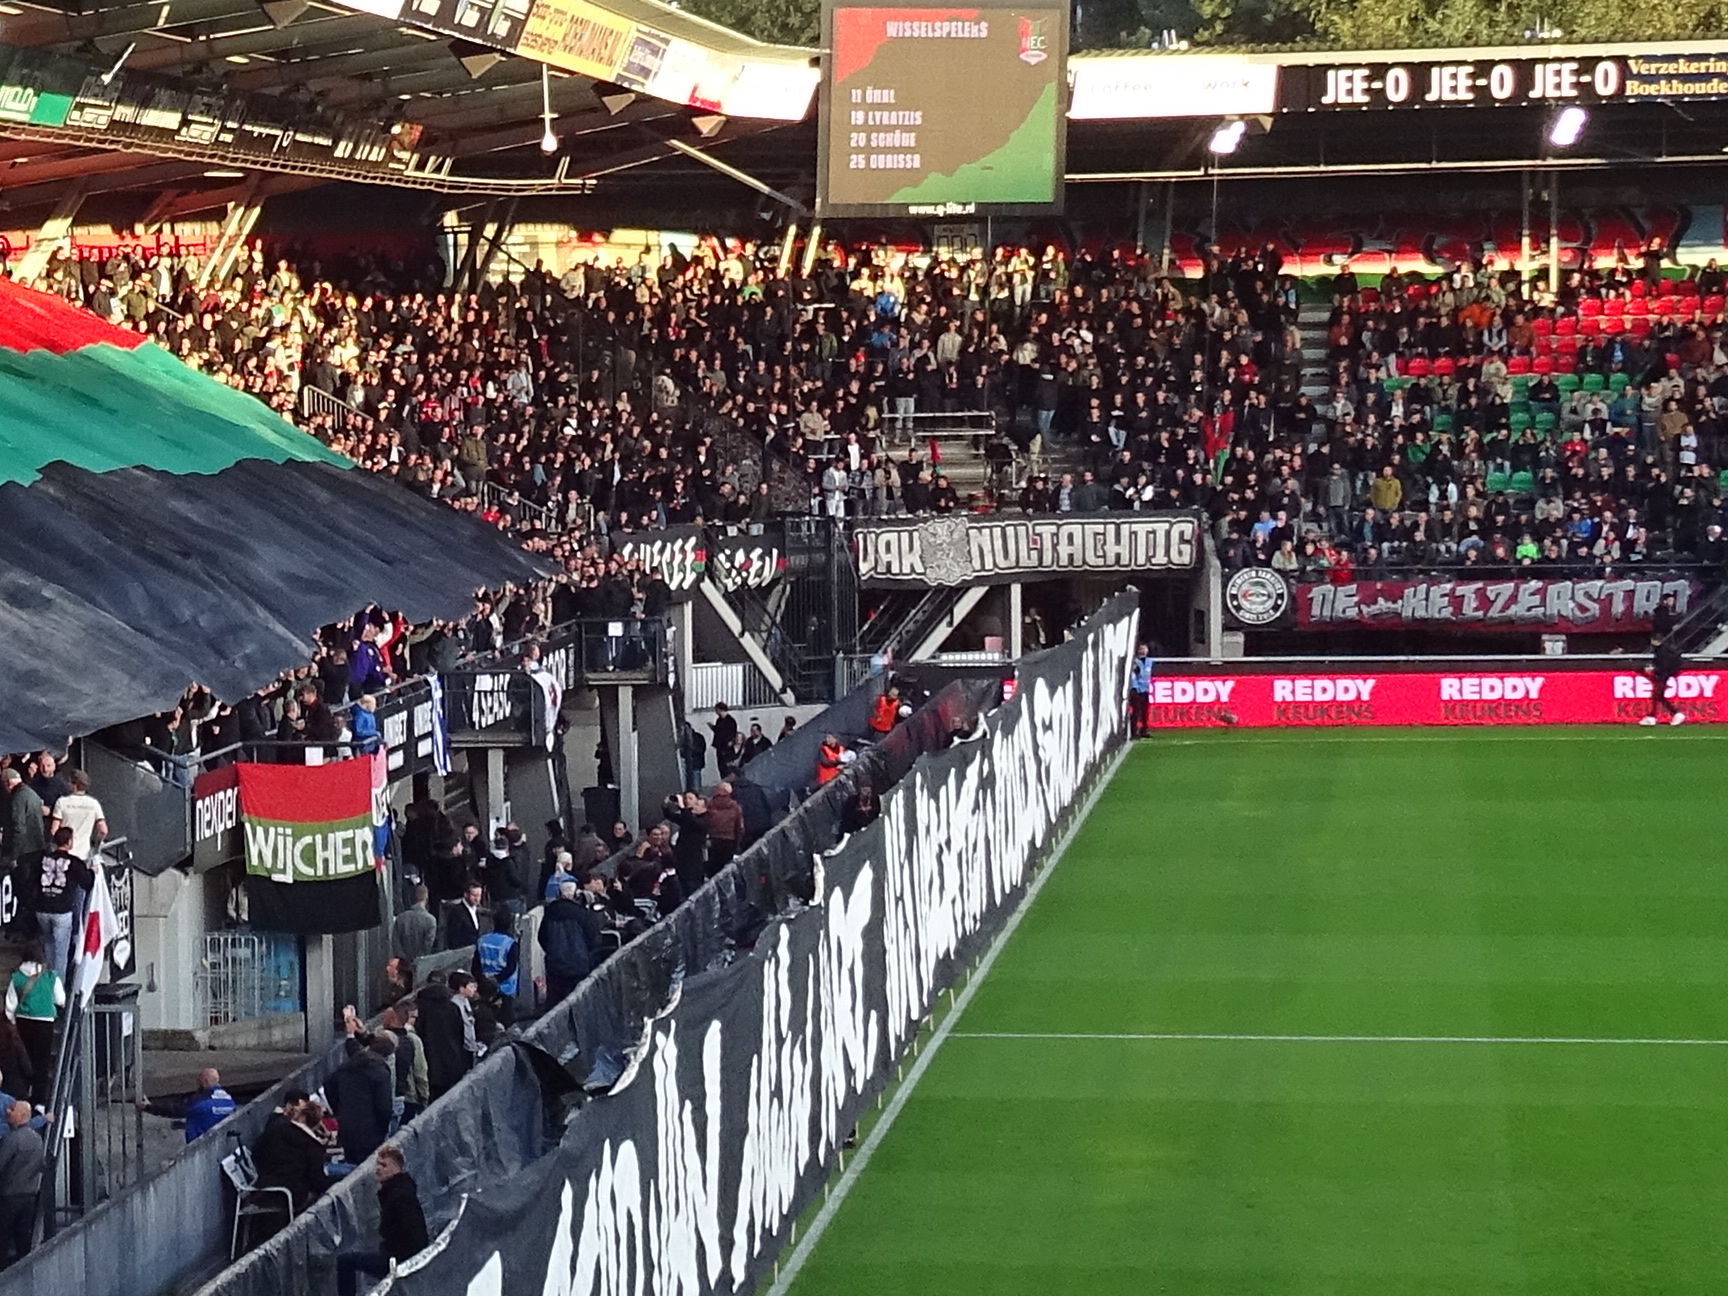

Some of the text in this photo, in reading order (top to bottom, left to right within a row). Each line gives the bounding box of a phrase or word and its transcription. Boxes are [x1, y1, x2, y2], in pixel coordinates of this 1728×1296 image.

[885, 21, 989, 39] WISSELSPELERS
[1627, 57, 1728, 76] Verzekerin
[1320, 60, 1620, 104] JEE-O JEE-O JEE-O
[1624, 79, 1728, 97] Boekhoude
[850, 88, 863, 104] 11
[850, 110, 865, 126] 19
[849, 132, 866, 148] 20
[849, 154, 866, 170] 25
[855, 519, 1197, 578] VAK NULTACHTIG
[1272, 678, 1377, 702] REDDY
[1440, 676, 1545, 702] REDDY
[1149, 704, 1233, 723] EUKENS
[1275, 703, 1376, 722] KEUKENS
[1442, 701, 1544, 721] KEUKENS
